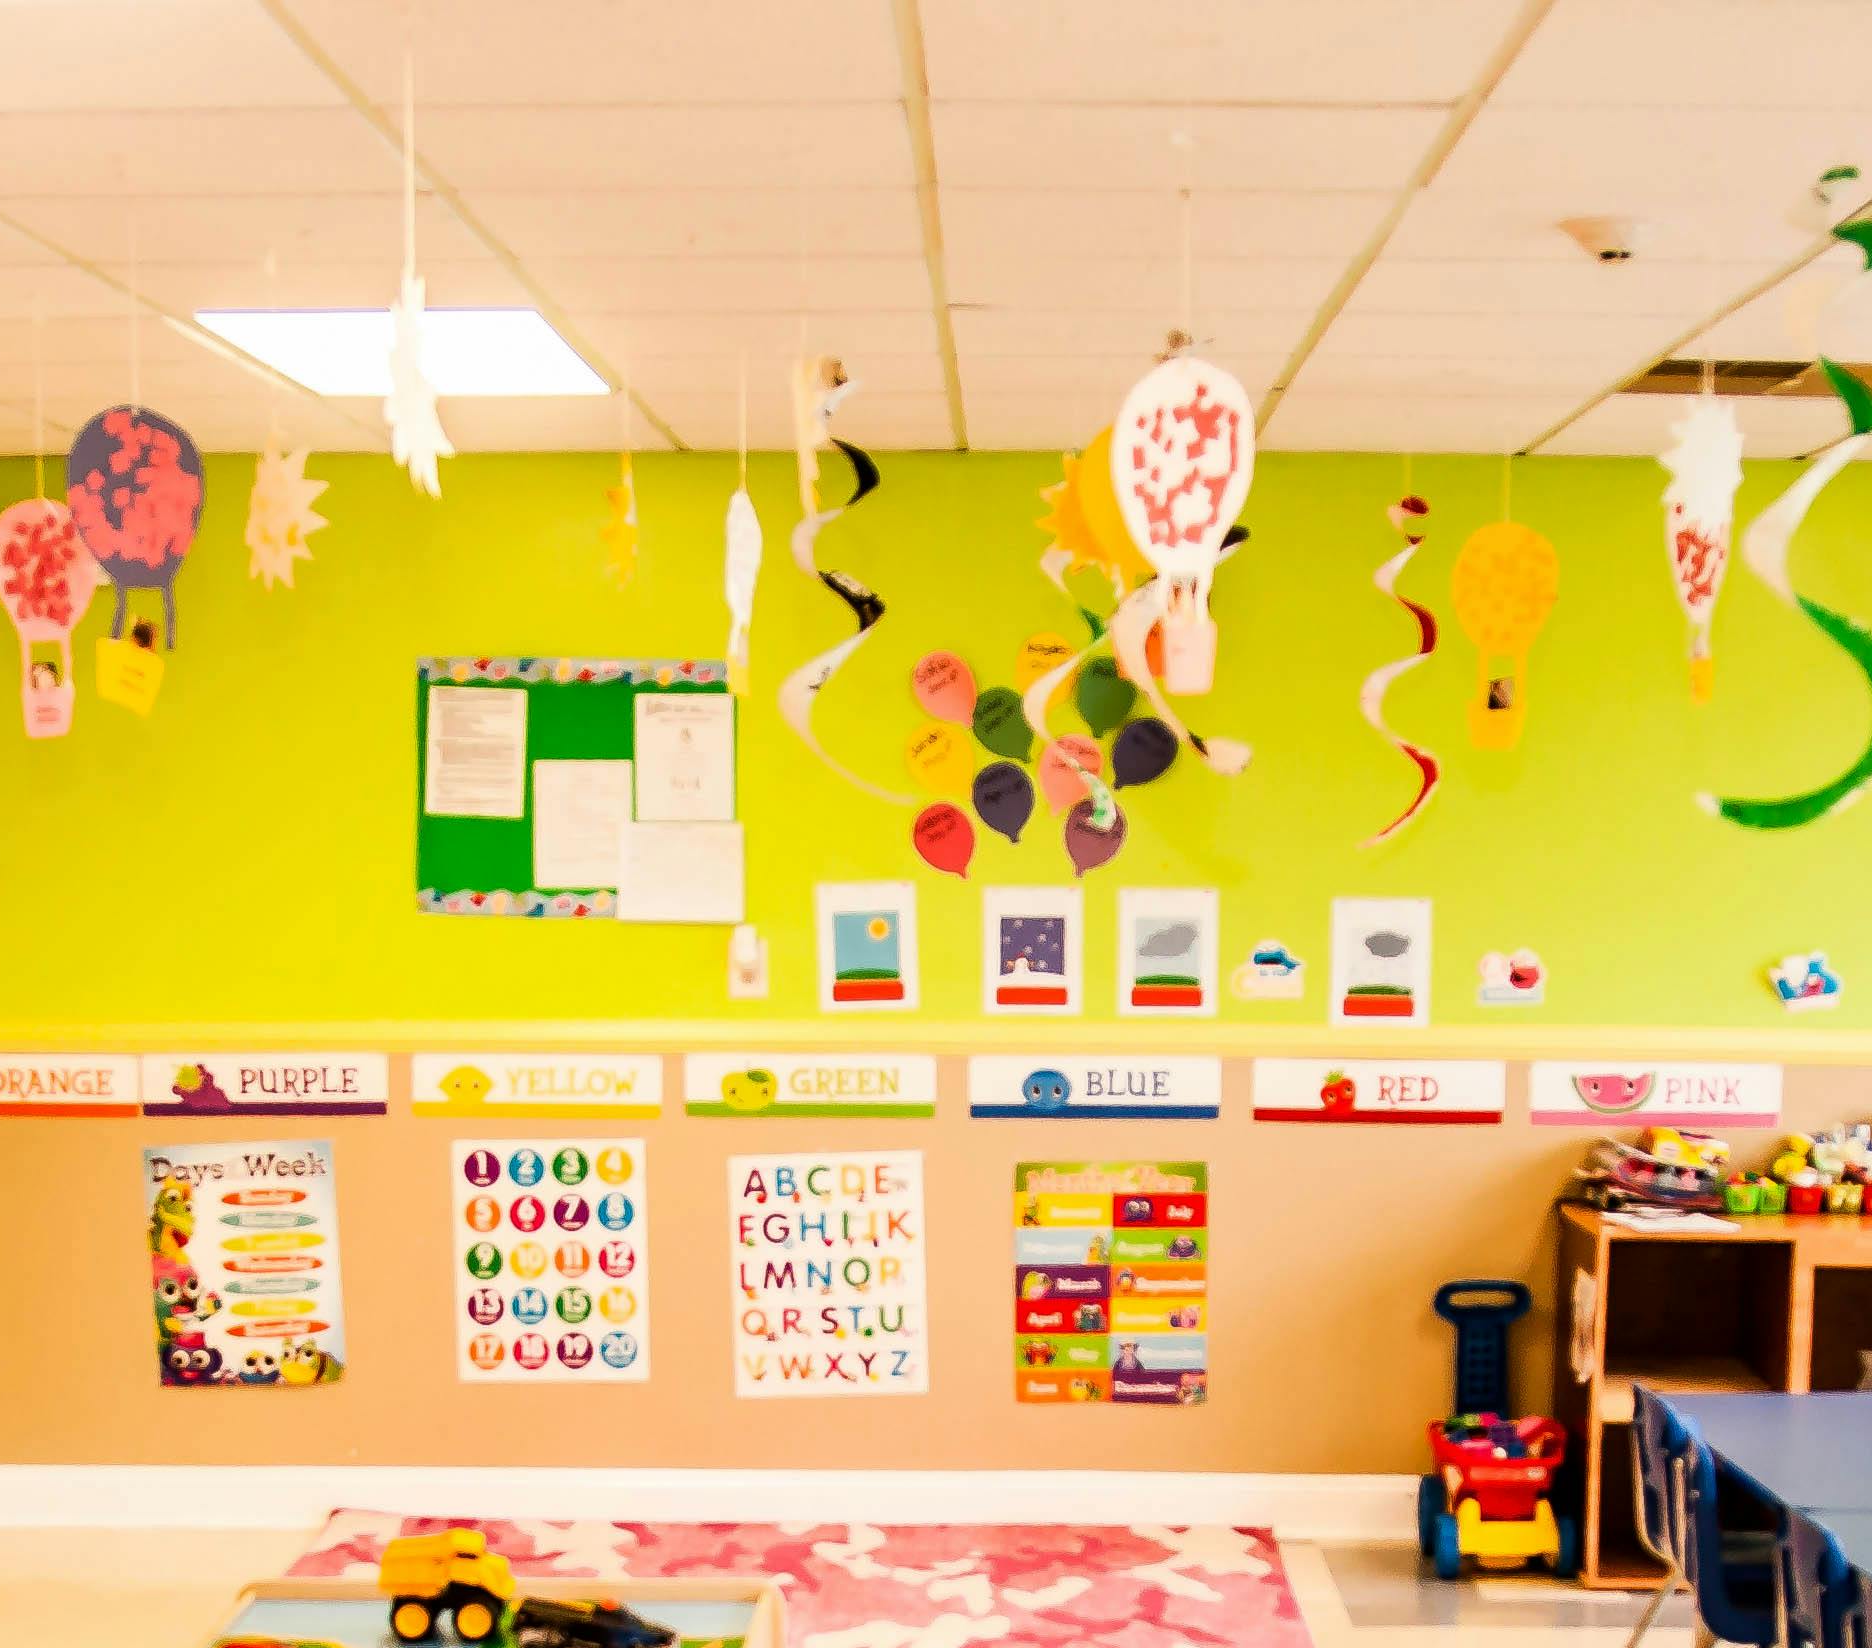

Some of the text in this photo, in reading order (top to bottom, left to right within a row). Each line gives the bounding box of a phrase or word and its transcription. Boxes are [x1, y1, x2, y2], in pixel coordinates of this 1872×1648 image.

[239, 1066, 360, 1098] PURPLE
[504, 1066, 639, 1097] YELLOW
[788, 1067, 902, 1097] GREEN
[1085, 1070, 1172, 1098] BLUE
[1376, 1073, 1440, 1105] RED
[1664, 1077, 1743, 1105] PINK
[149, 1151, 327, 1187] Days Week
